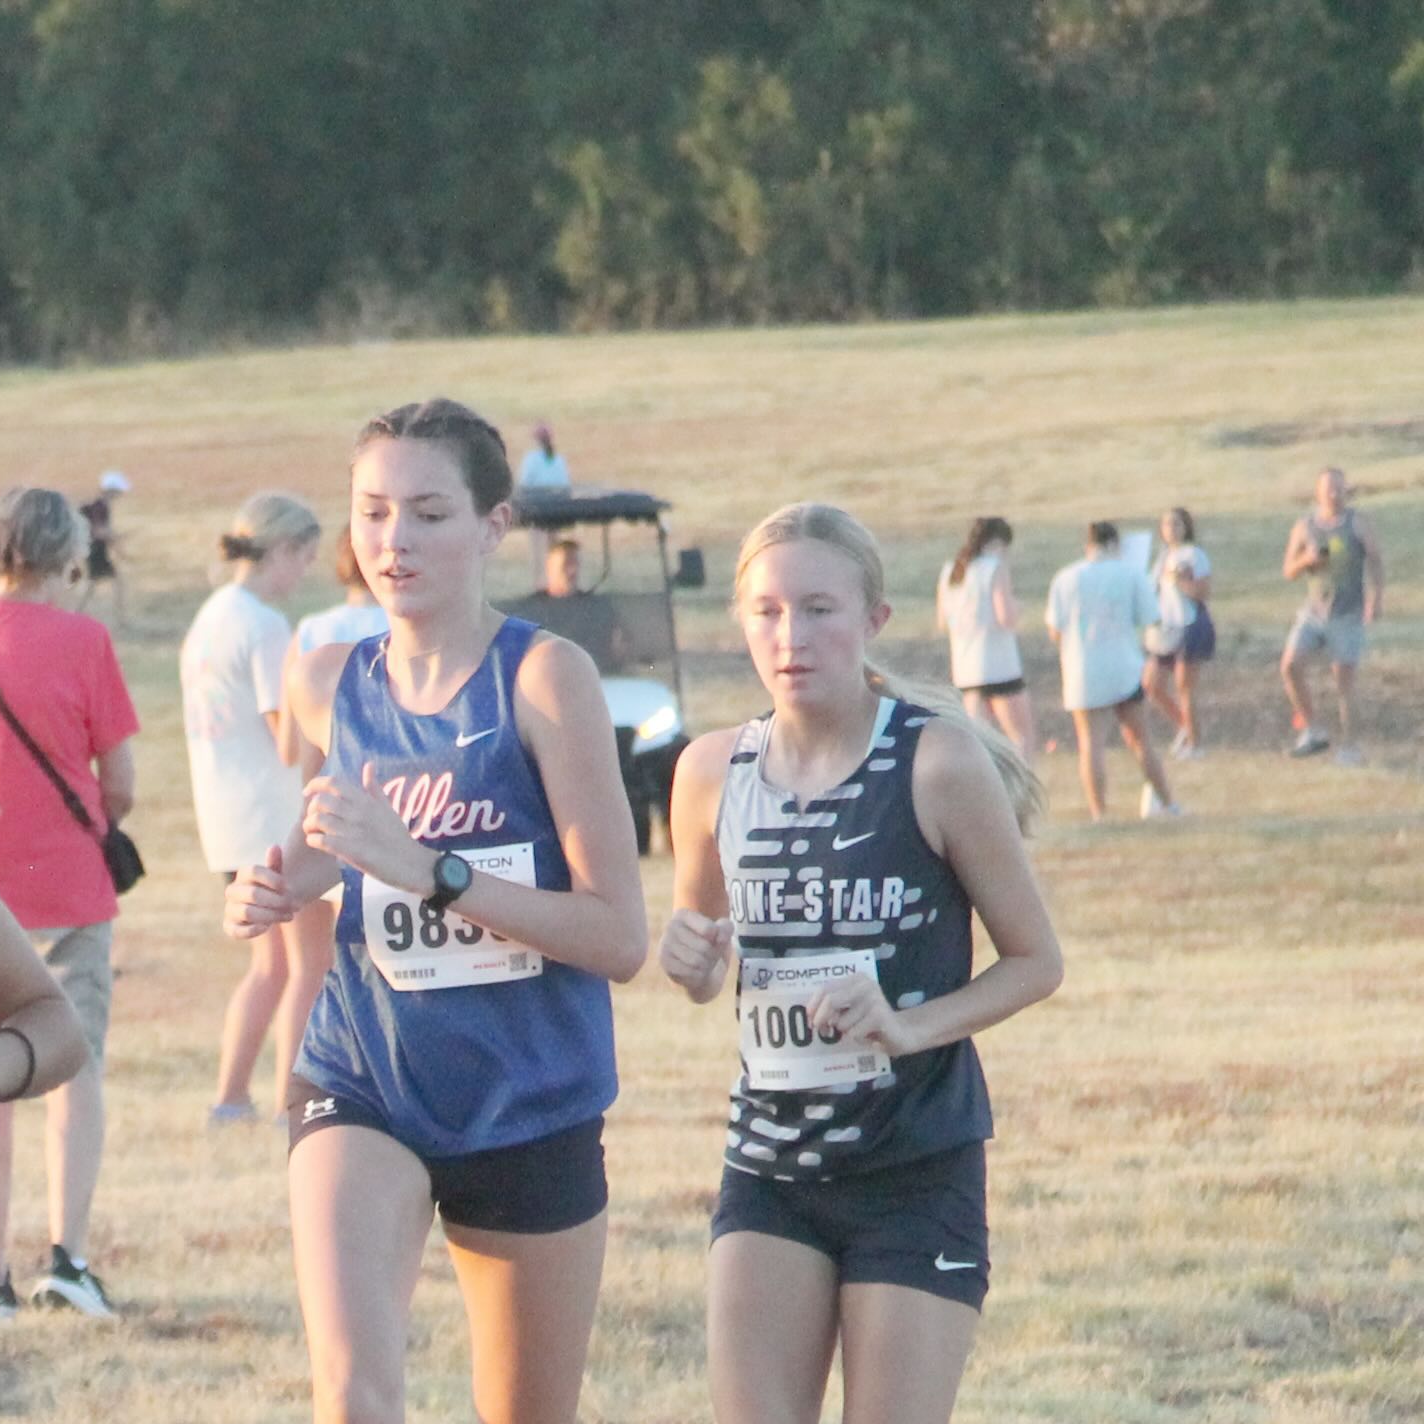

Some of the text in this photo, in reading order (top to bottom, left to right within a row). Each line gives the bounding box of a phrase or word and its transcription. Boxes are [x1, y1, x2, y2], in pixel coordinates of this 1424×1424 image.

[803, 876, 905, 923] STAR
[776, 964, 857, 981] COMPTON
[748, 1004, 843, 1049] 100
